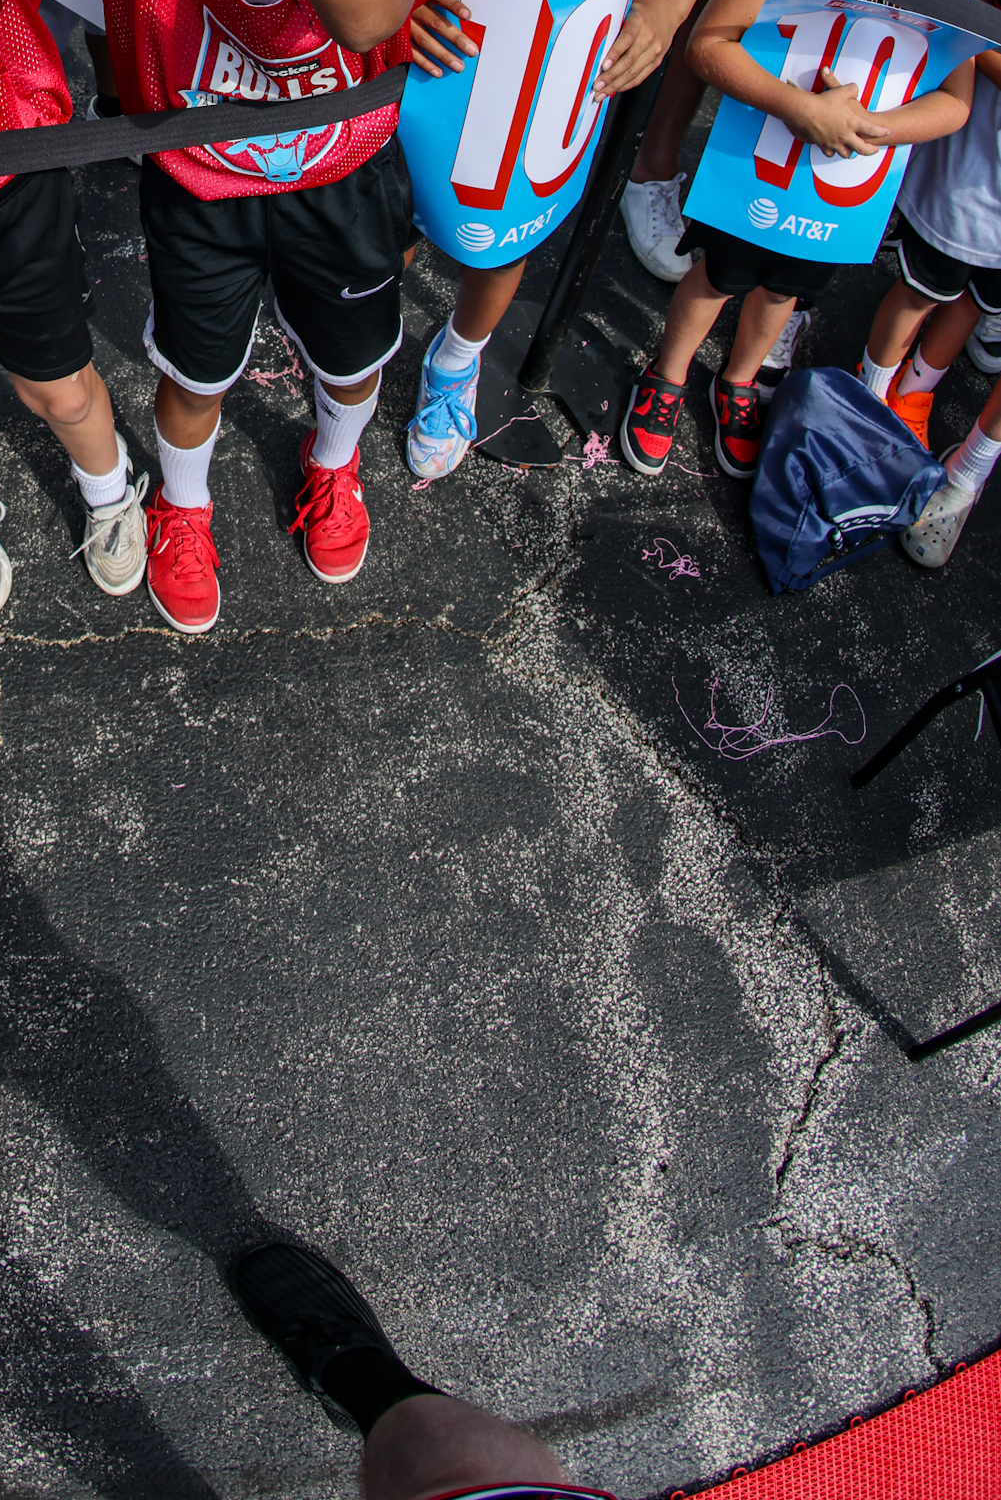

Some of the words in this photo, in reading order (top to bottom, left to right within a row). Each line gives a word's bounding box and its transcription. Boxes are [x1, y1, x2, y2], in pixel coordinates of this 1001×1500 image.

[830, 1, 872, 13] BULLS
[753, 10, 929, 208] 10
[498, 203, 558, 248] AT&T
[779, 215, 839, 241] AT&T
